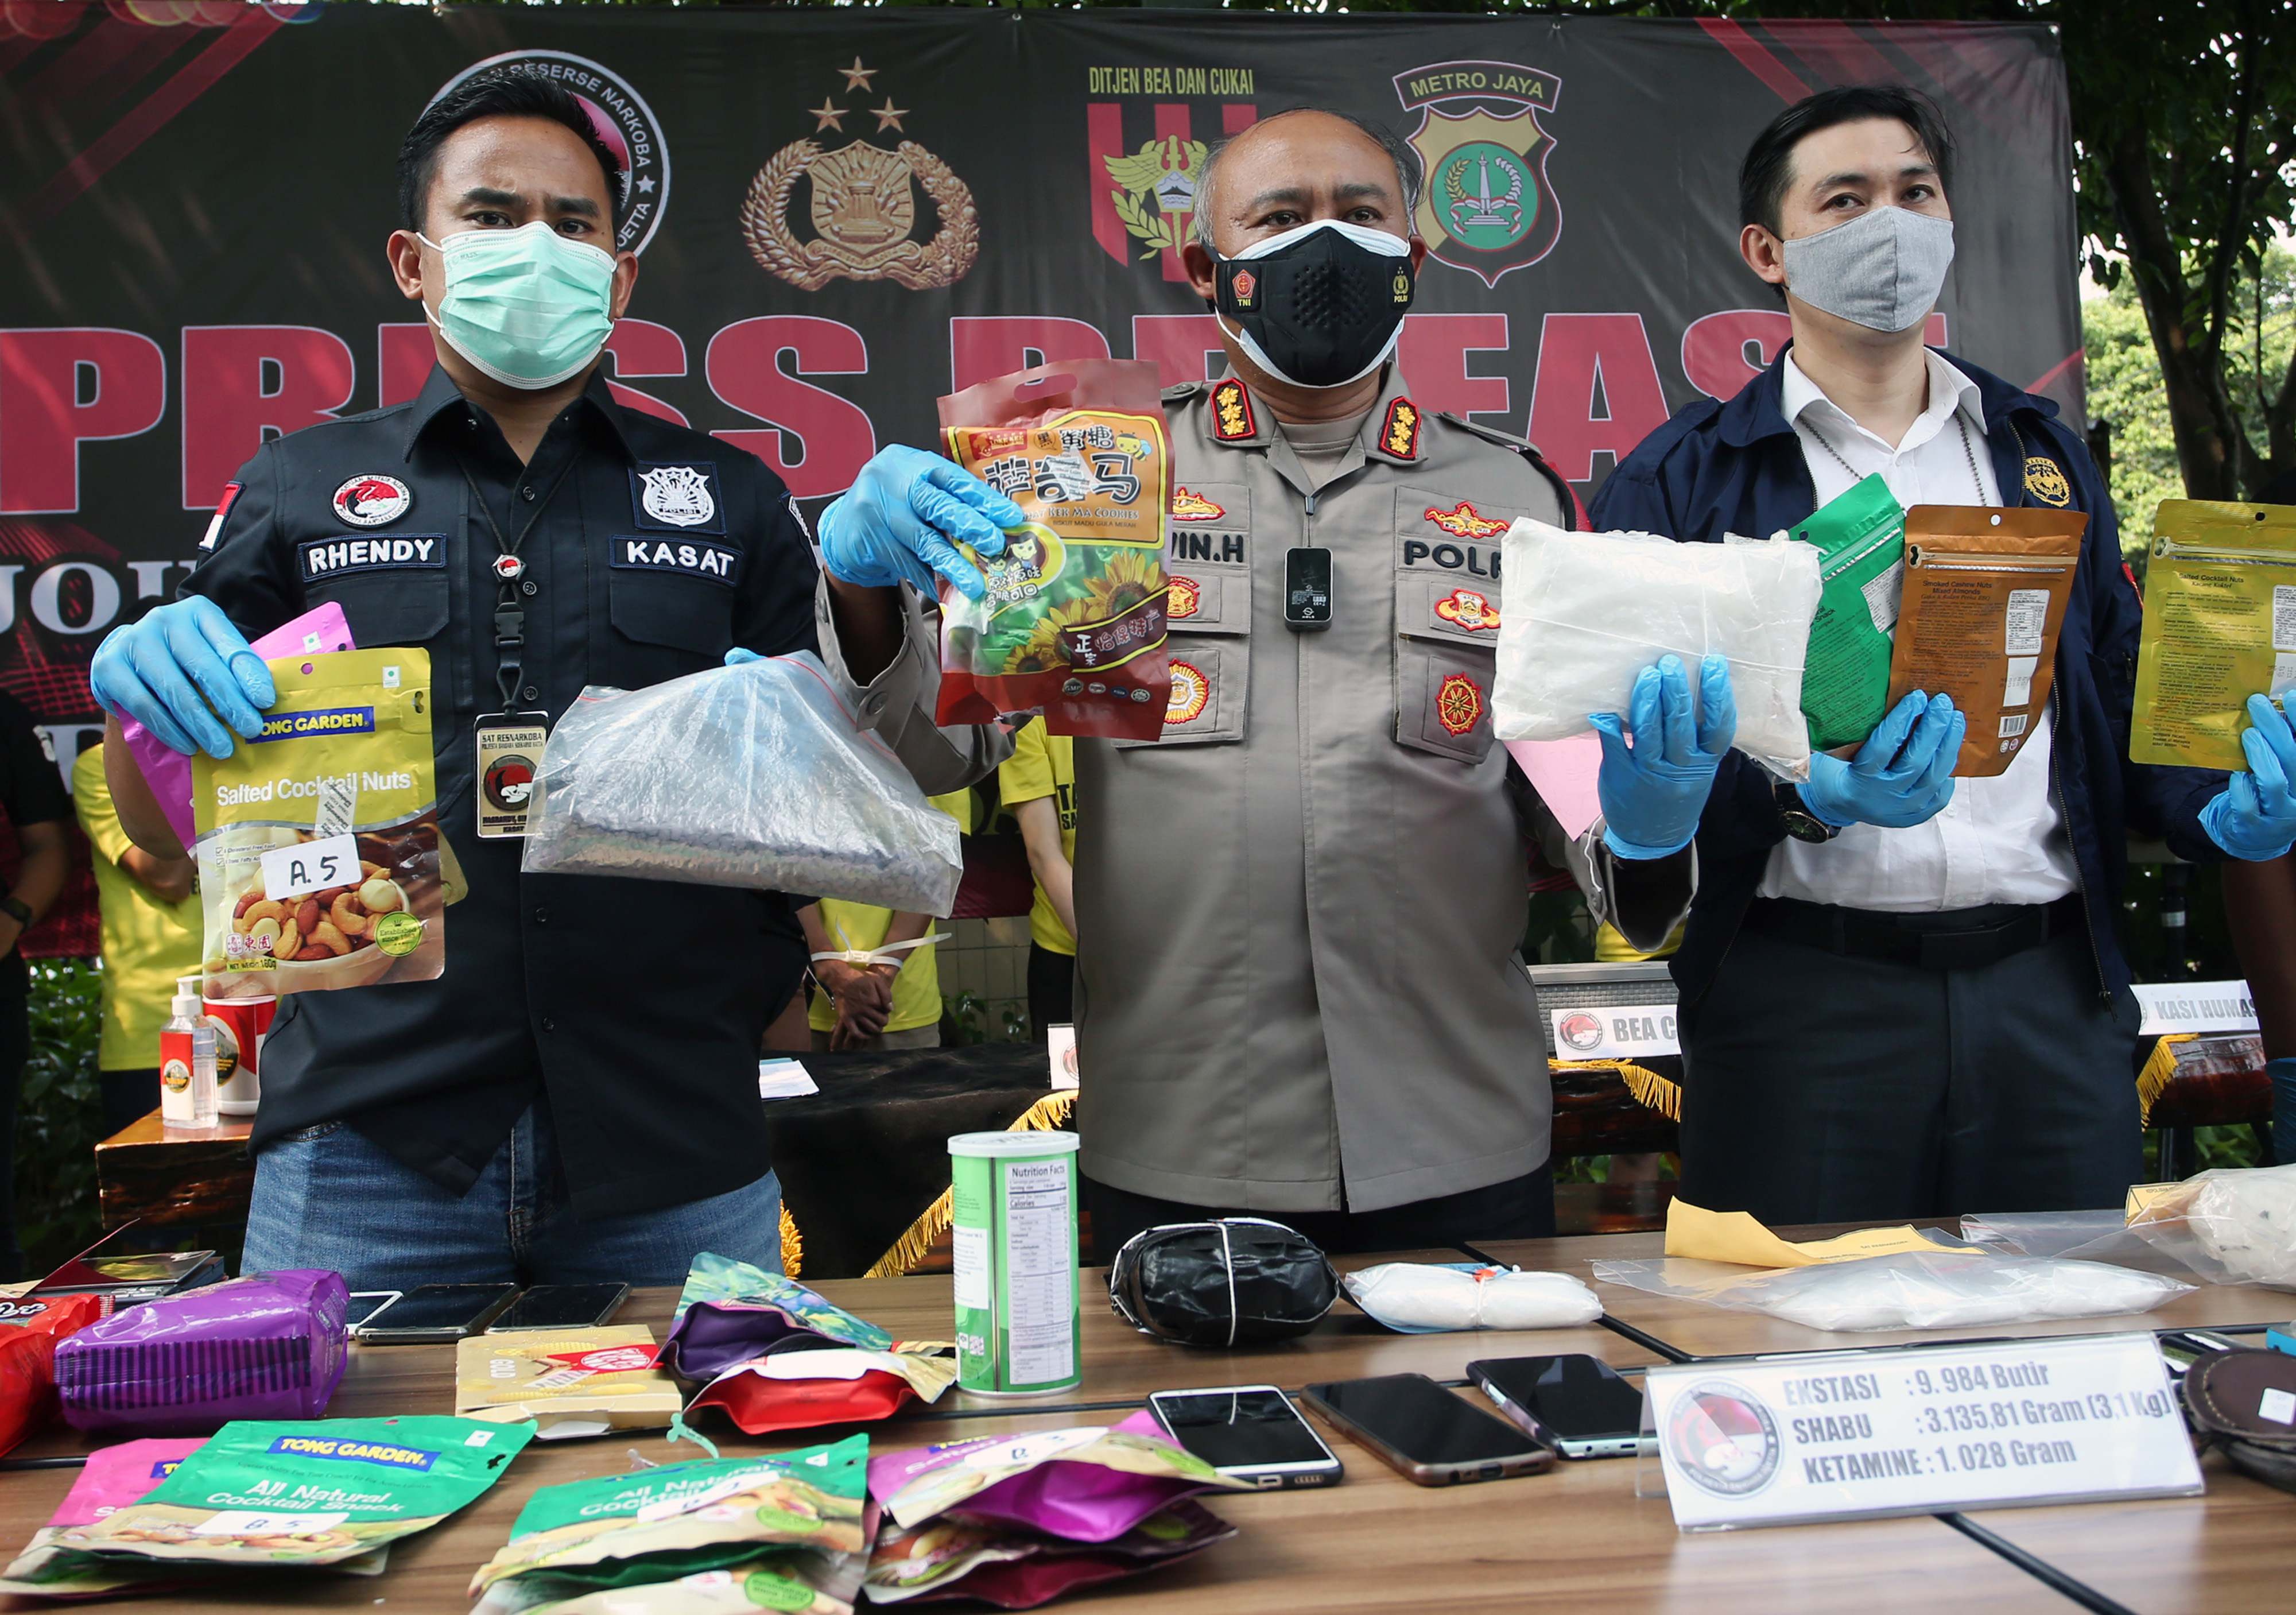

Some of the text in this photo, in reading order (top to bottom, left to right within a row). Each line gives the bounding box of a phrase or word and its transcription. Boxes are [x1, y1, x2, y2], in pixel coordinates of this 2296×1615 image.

[1089, 67, 1254, 95] DITJEN BEA DAN CUKAI
[1410, 71, 1544, 99] METRO JAYA
[600, 87, 651, 168] NARKOBA
[1238, 299, 1251, 307] TNI
[308, 538, 436, 573] RHENDY
[627, 541, 734, 576] KASAT
[1172, 532, 1244, 563] IN.H
[1923, 580, 1949, 588] Smoked
[260, 719, 292, 737] ONG
[482, 732, 542, 743] SAT RESNARKOBA
[217, 771, 412, 807] Salted Cocktail Nuts
[2155, 1000, 2198, 1020] KASI
[1612, 1017, 1658, 1042] BEA
[1012, 1165, 1065, 1178] Nutrition Facts
[1010, 1199, 1035, 1208] Calories
[1782, 1374, 1881, 1406] EKSTASI
[1990, 1361, 2049, 1389] Butir
[1792, 1413, 1873, 1444] SHABU
[2021, 1399, 2086, 1425] Gram
[2129, 1389, 2171, 1418] Kg)
[280, 1438, 424, 1467] TONG GARDEN
[1802, 1449, 1923, 1484] KETAMINE
[2010, 1439, 2077, 1466] Gram
[206, 1492, 405, 1513] Cocktail Snack
[245, 1479, 393, 1504] All Natural
[614, 1485, 652, 1501] All
